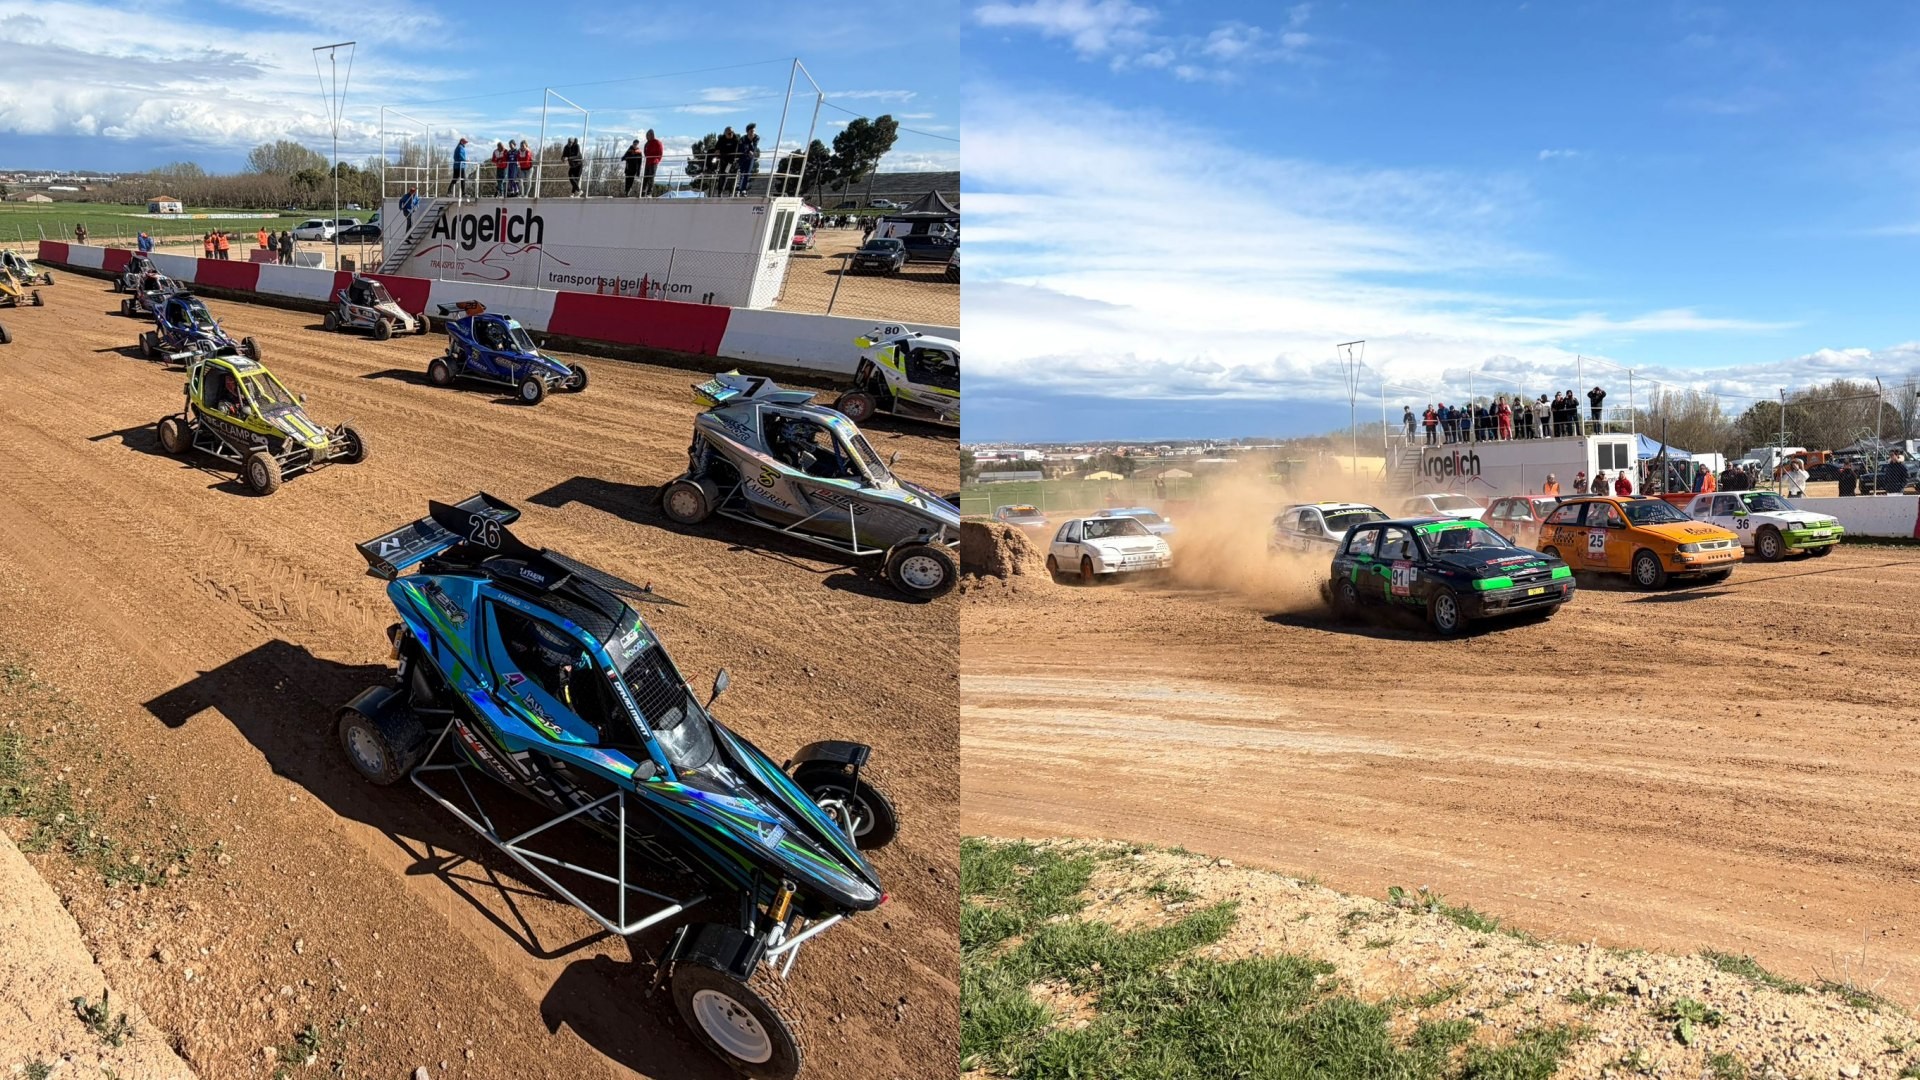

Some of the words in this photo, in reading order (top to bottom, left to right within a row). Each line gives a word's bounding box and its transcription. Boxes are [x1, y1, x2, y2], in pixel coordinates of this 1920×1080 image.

[432, 207, 544, 251] Argelich
[549, 271, 692, 294] transportsagelich.com
[884, 326, 900, 335] 80
[742, 377, 767, 398] 7
[1417, 450, 1480, 483] Argelich
[745, 476, 792, 509] TADEREM
[468, 513, 501, 550] 26
[1736, 518, 1750, 530] 36
[1367, 530, 1377, 544] 91
[1589, 535, 1604, 547] 25
[1392, 569, 1404, 586] 91
[614, 681, 633, 709] DAVID
